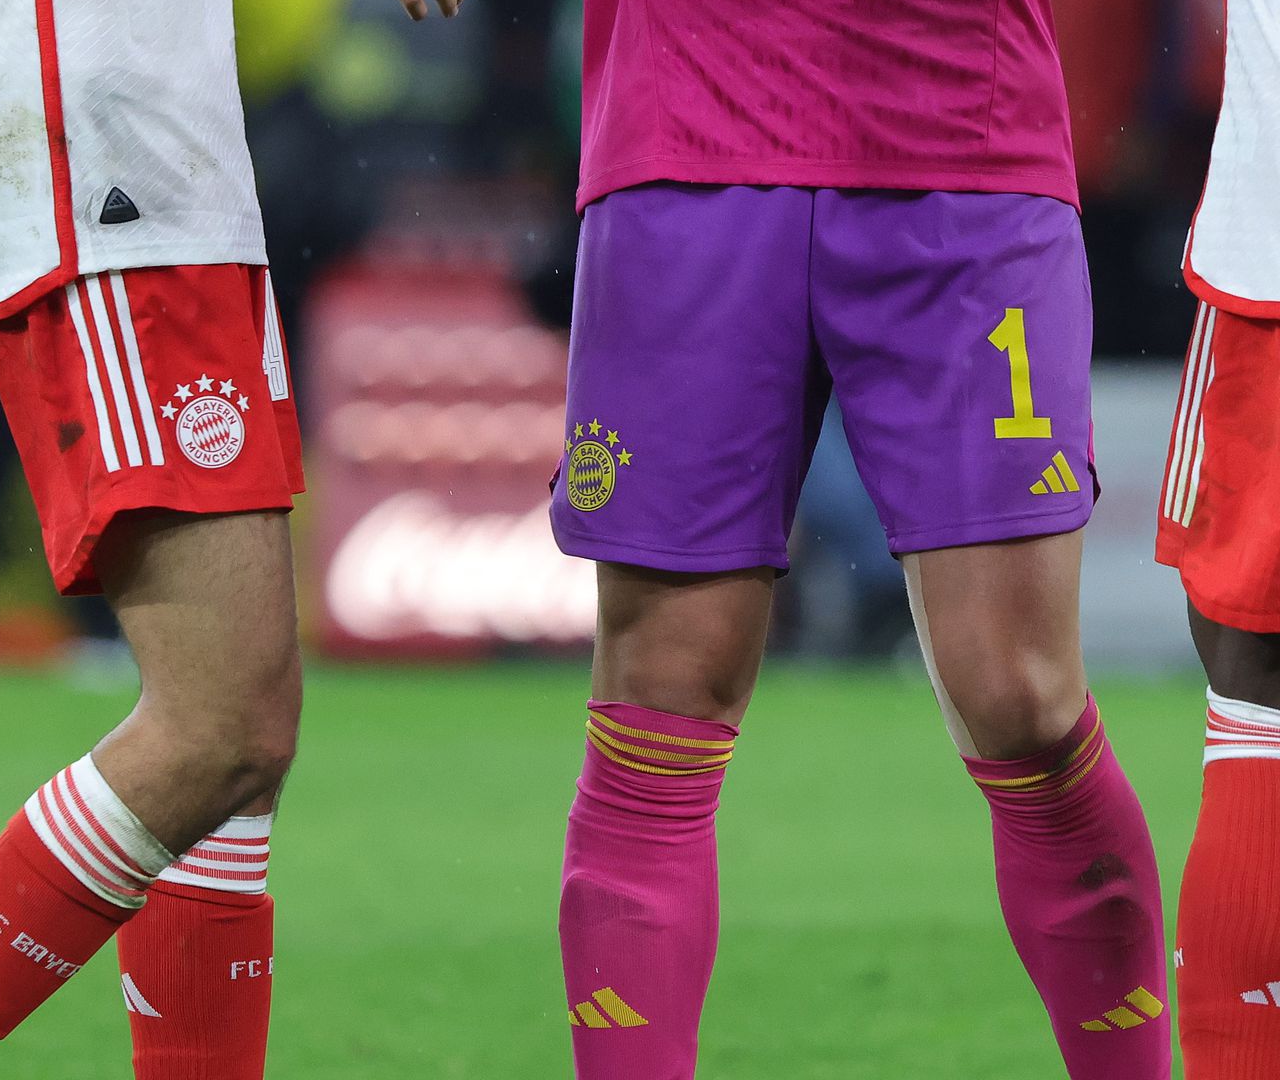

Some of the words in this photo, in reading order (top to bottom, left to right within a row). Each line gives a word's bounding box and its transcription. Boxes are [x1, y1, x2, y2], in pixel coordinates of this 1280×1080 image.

[987, 307, 1052, 439] 1
[182, 413, 195, 430] FC
[194, 401, 237, 425] BAYERN
[580, 447, 610, 475] BAYERN
[230, 959, 262, 980] FC
